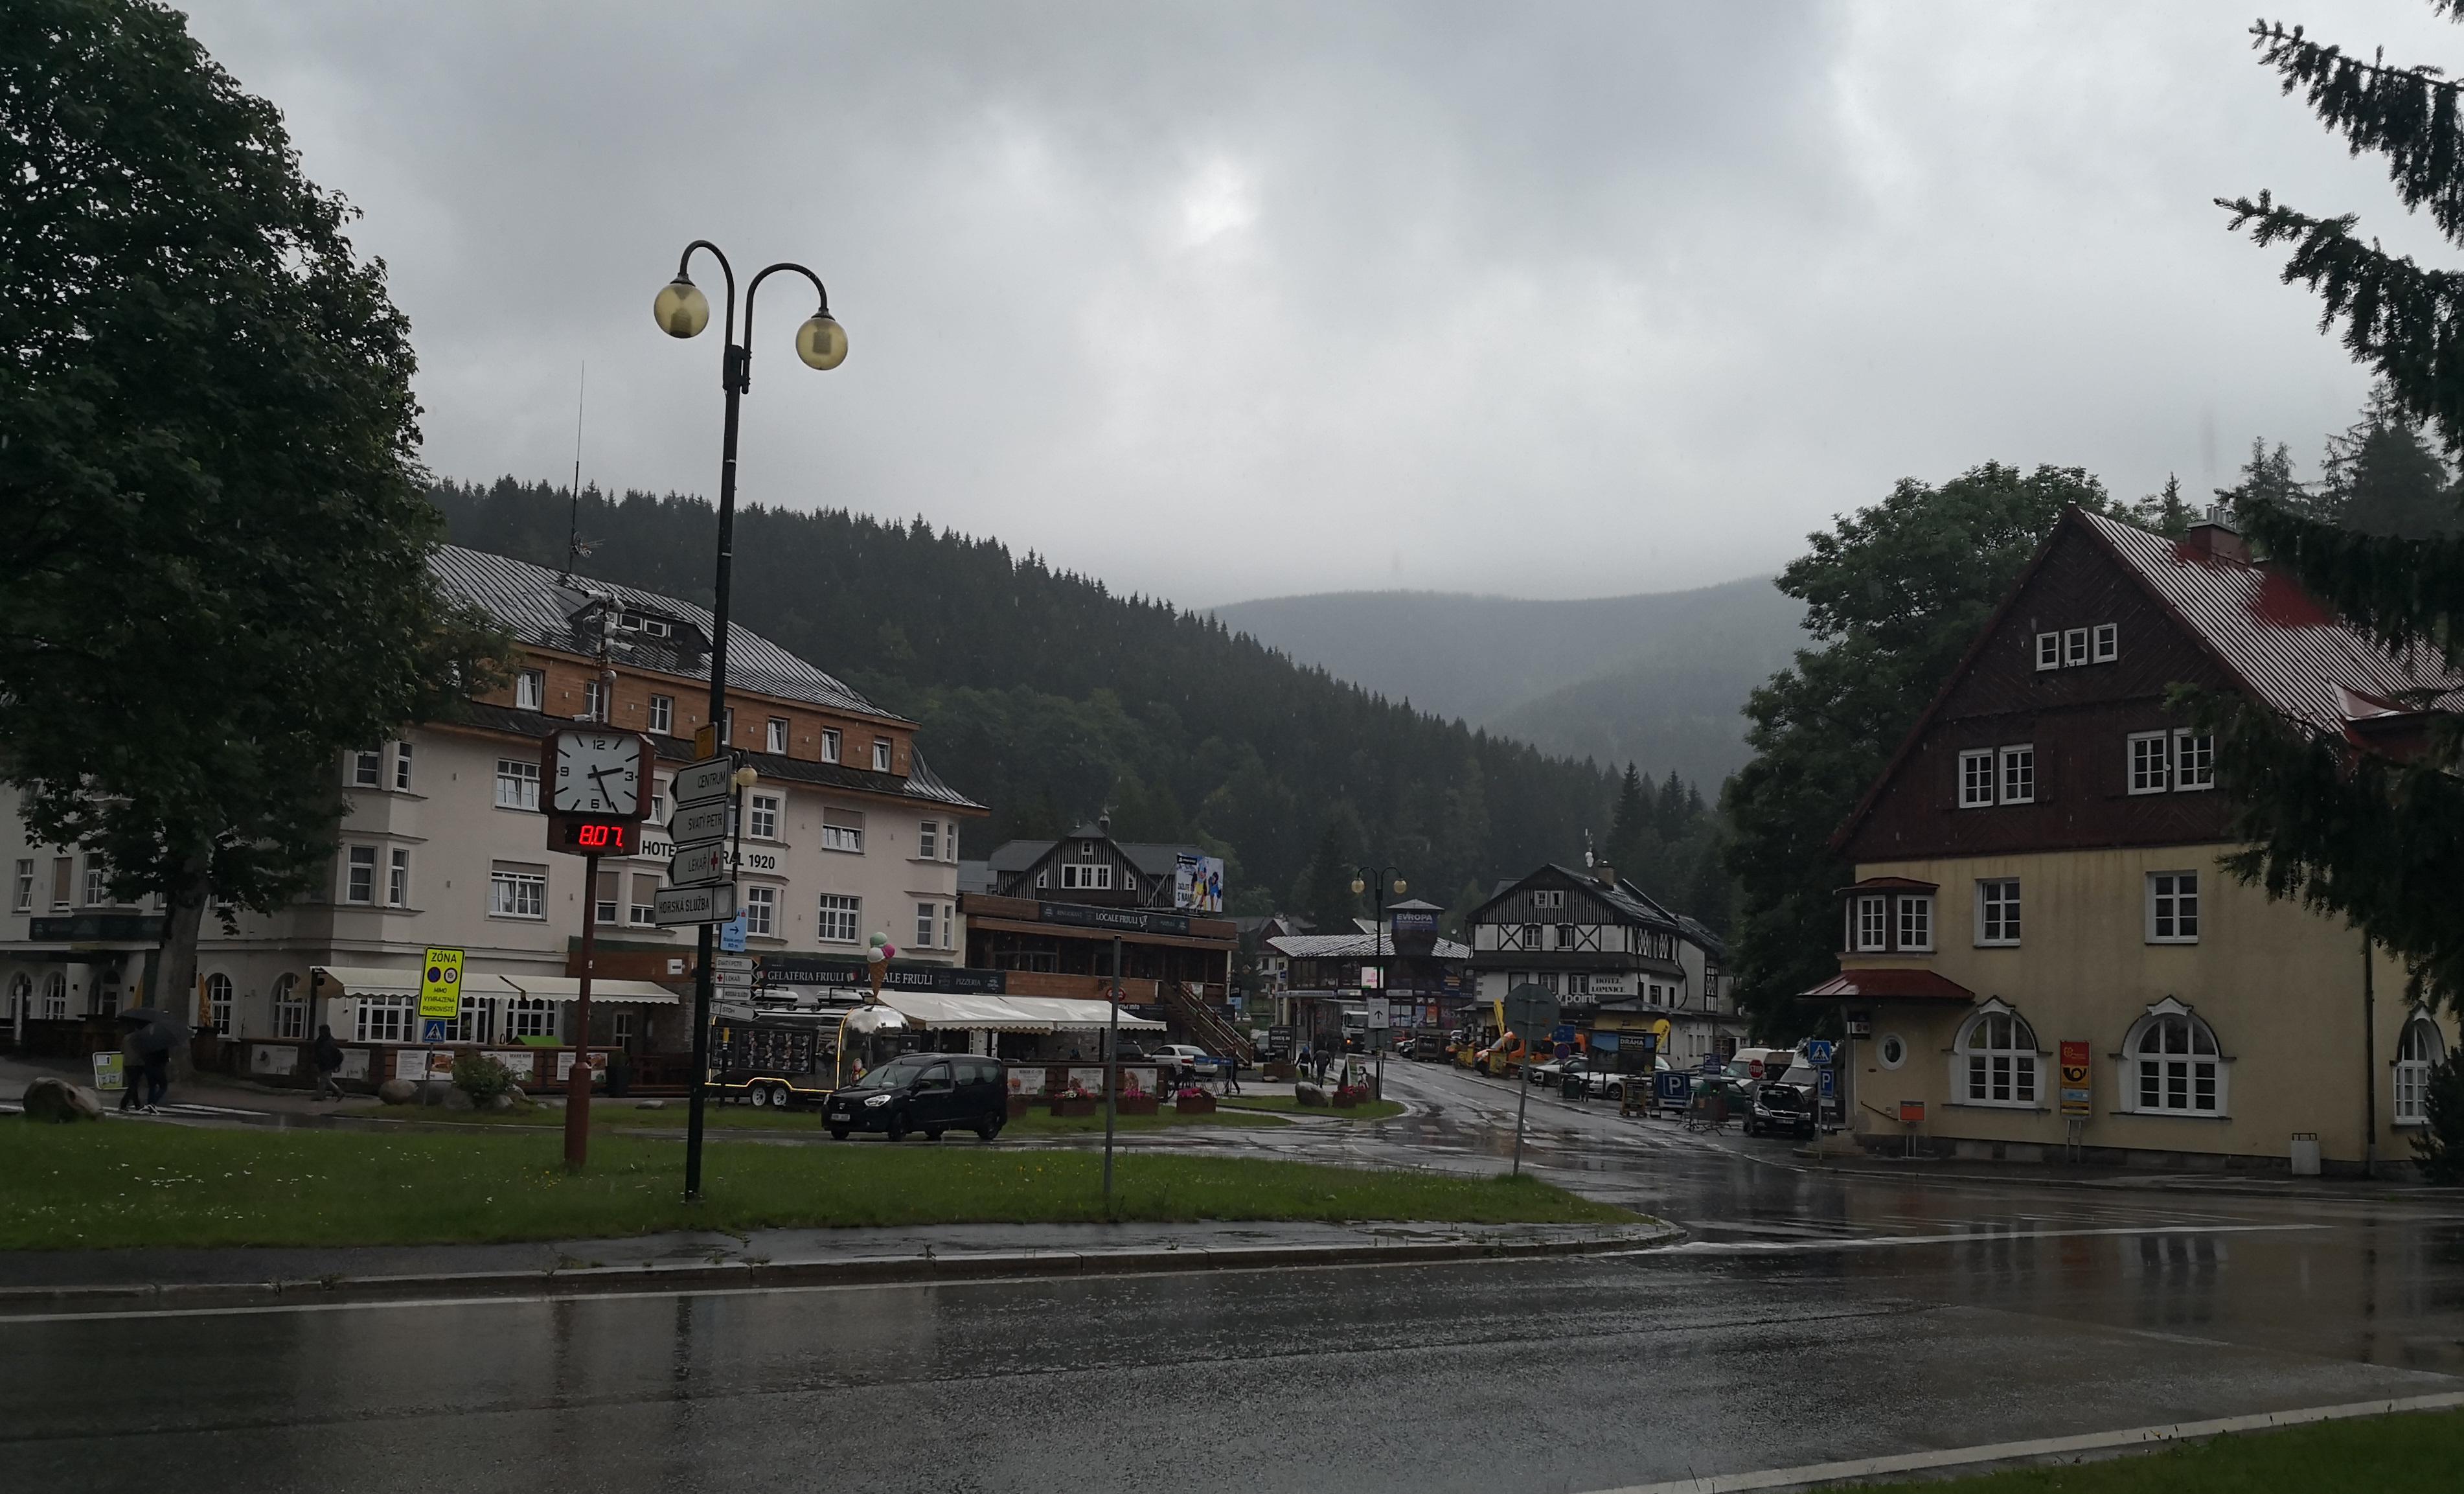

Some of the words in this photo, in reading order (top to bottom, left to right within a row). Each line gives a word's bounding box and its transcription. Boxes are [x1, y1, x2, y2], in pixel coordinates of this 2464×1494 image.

[593, 740, 606, 750] 12
[560, 767, 569, 776] 9
[625, 771, 633, 781] 3
[698, 770, 726, 788] CENTRUM
[591, 799, 600, 809] 6
[707, 813, 723, 829] PETR
[642, 840, 676, 857] HOTE
[749, 854, 775, 869] 1920
[659, 897, 685, 914] HORSKÁ
[685, 895, 710, 912] SLUŽBA
[1095, 912, 1119, 923] LOCALE
[1119, 914, 1138, 925] FRIULI
[1139, 914, 1148, 927] UP
[431, 951, 457, 963] ZÓNA
[768, 971, 814, 981] GELATERIA
[816, 972, 844, 982] FRIULI
[903, 973, 933, 985] FRIULI
[1565, 993, 1599, 1006] point
[1669, 1076, 1682, 1095] P
[1822, 1072, 1831, 1089] P
